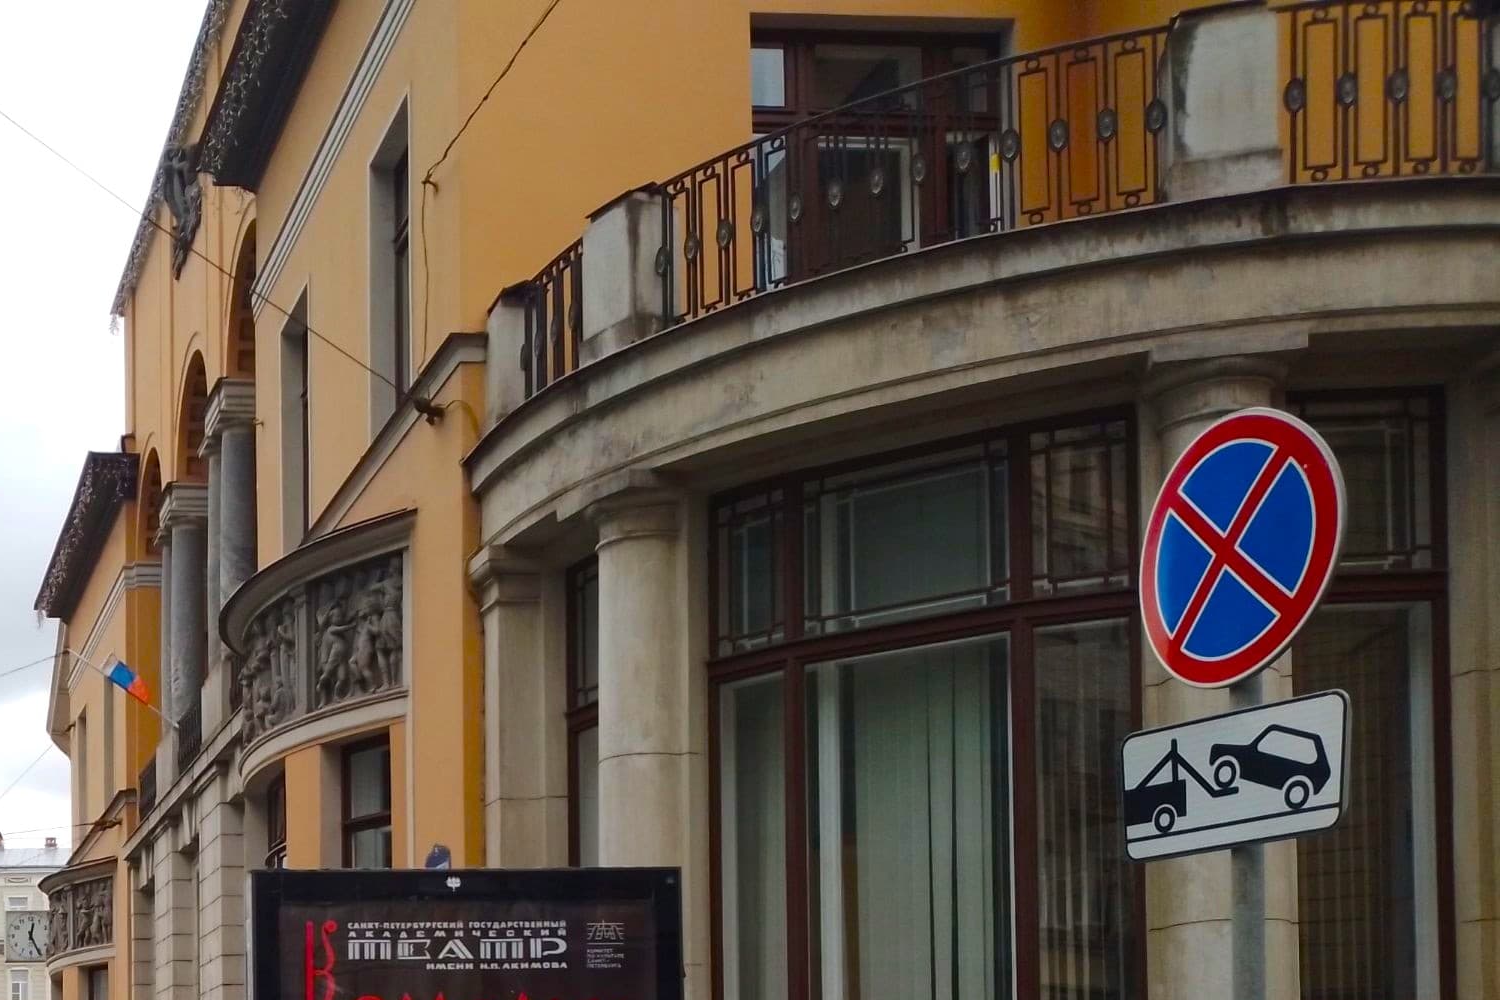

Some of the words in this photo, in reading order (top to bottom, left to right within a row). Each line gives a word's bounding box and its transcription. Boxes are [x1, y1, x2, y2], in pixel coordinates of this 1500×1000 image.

[347, 920, 464, 930] САНКТ-ПЕТЕРБУРГСКИЙ
[469, 920, 567, 930] ГОСУДАРСТВЕННЫЙ
[426, 962, 474, 970] ИМЕНИ
